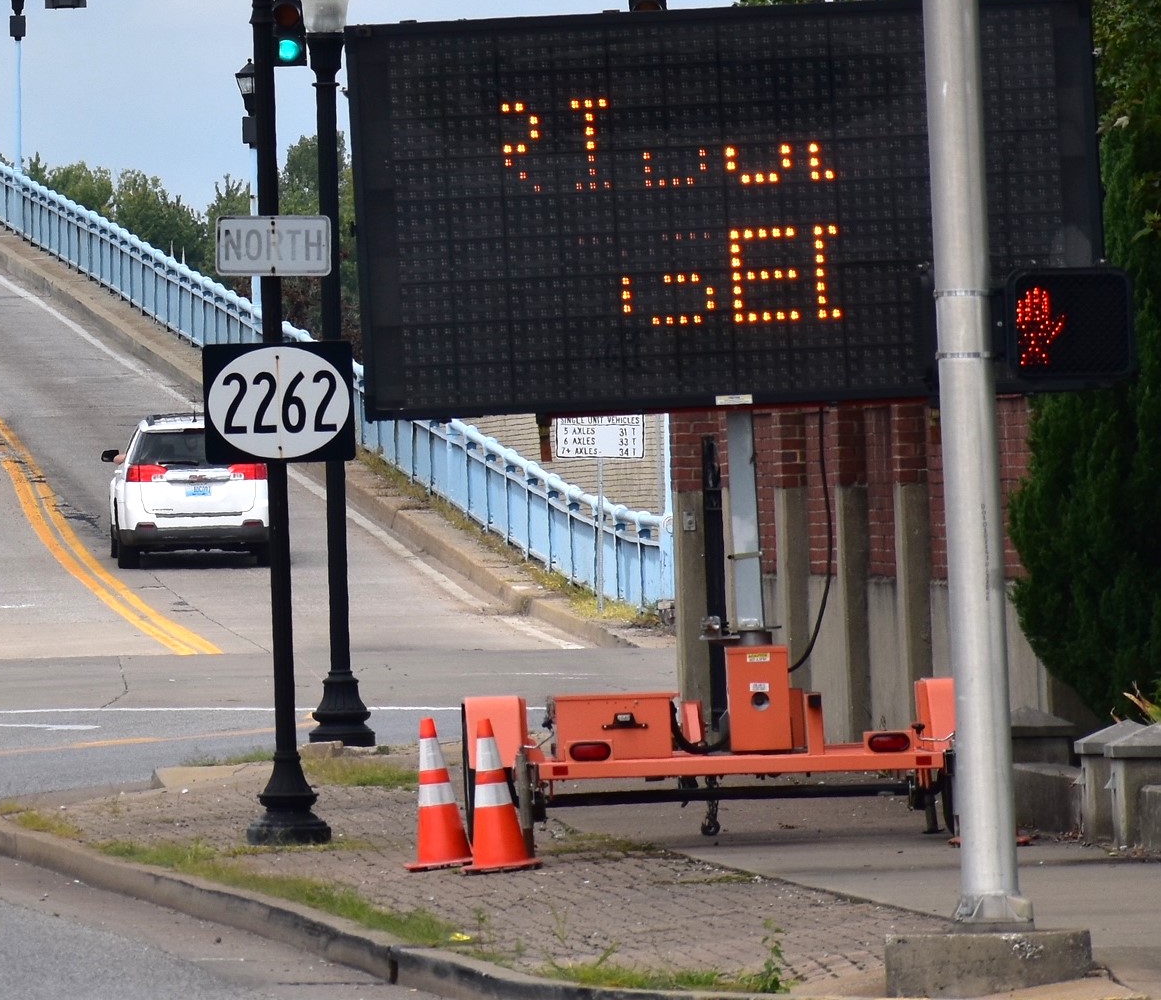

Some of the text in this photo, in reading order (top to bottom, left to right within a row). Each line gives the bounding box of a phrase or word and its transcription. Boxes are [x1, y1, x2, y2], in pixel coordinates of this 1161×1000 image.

[224, 229, 322, 261] NORTH
[222, 370, 337, 435] 2262
[587, 416, 603, 424] UNIT
[608, 416, 640, 424] VEHICLES
[564, 427, 568, 435] 5
[572, 427, 595, 435] AXLES
[619, 428, 627, 436] 31
[564, 437, 568, 445] 6
[572, 437, 595, 445] AXLES
[619, 448, 629, 456] 34
